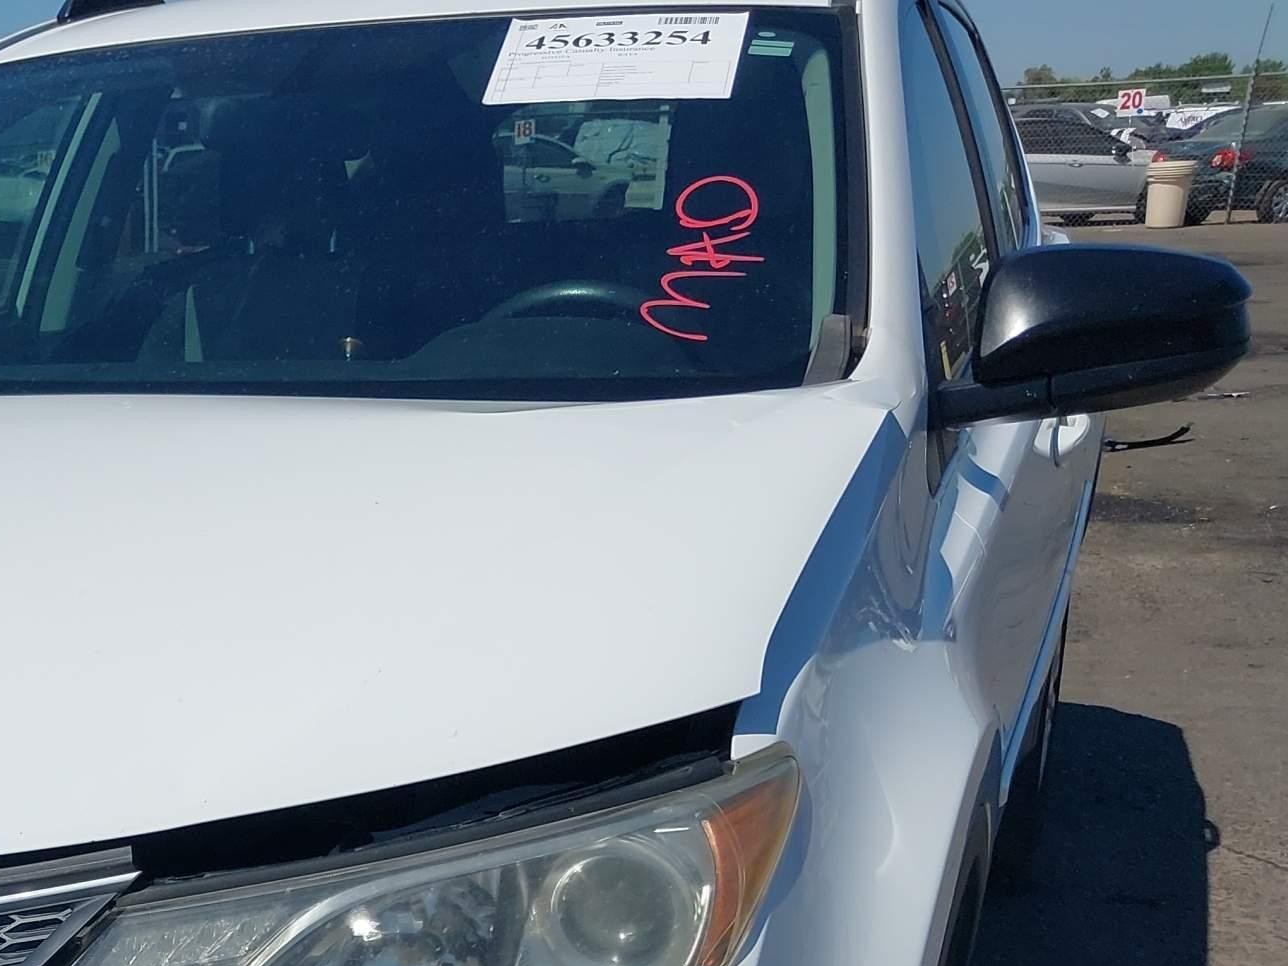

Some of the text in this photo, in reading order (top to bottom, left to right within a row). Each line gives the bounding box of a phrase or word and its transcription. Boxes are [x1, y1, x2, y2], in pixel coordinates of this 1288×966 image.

[524, 30, 712, 50] 45633254
[1119, 91, 1144, 110] 20
[517, 121, 532, 137] 18
